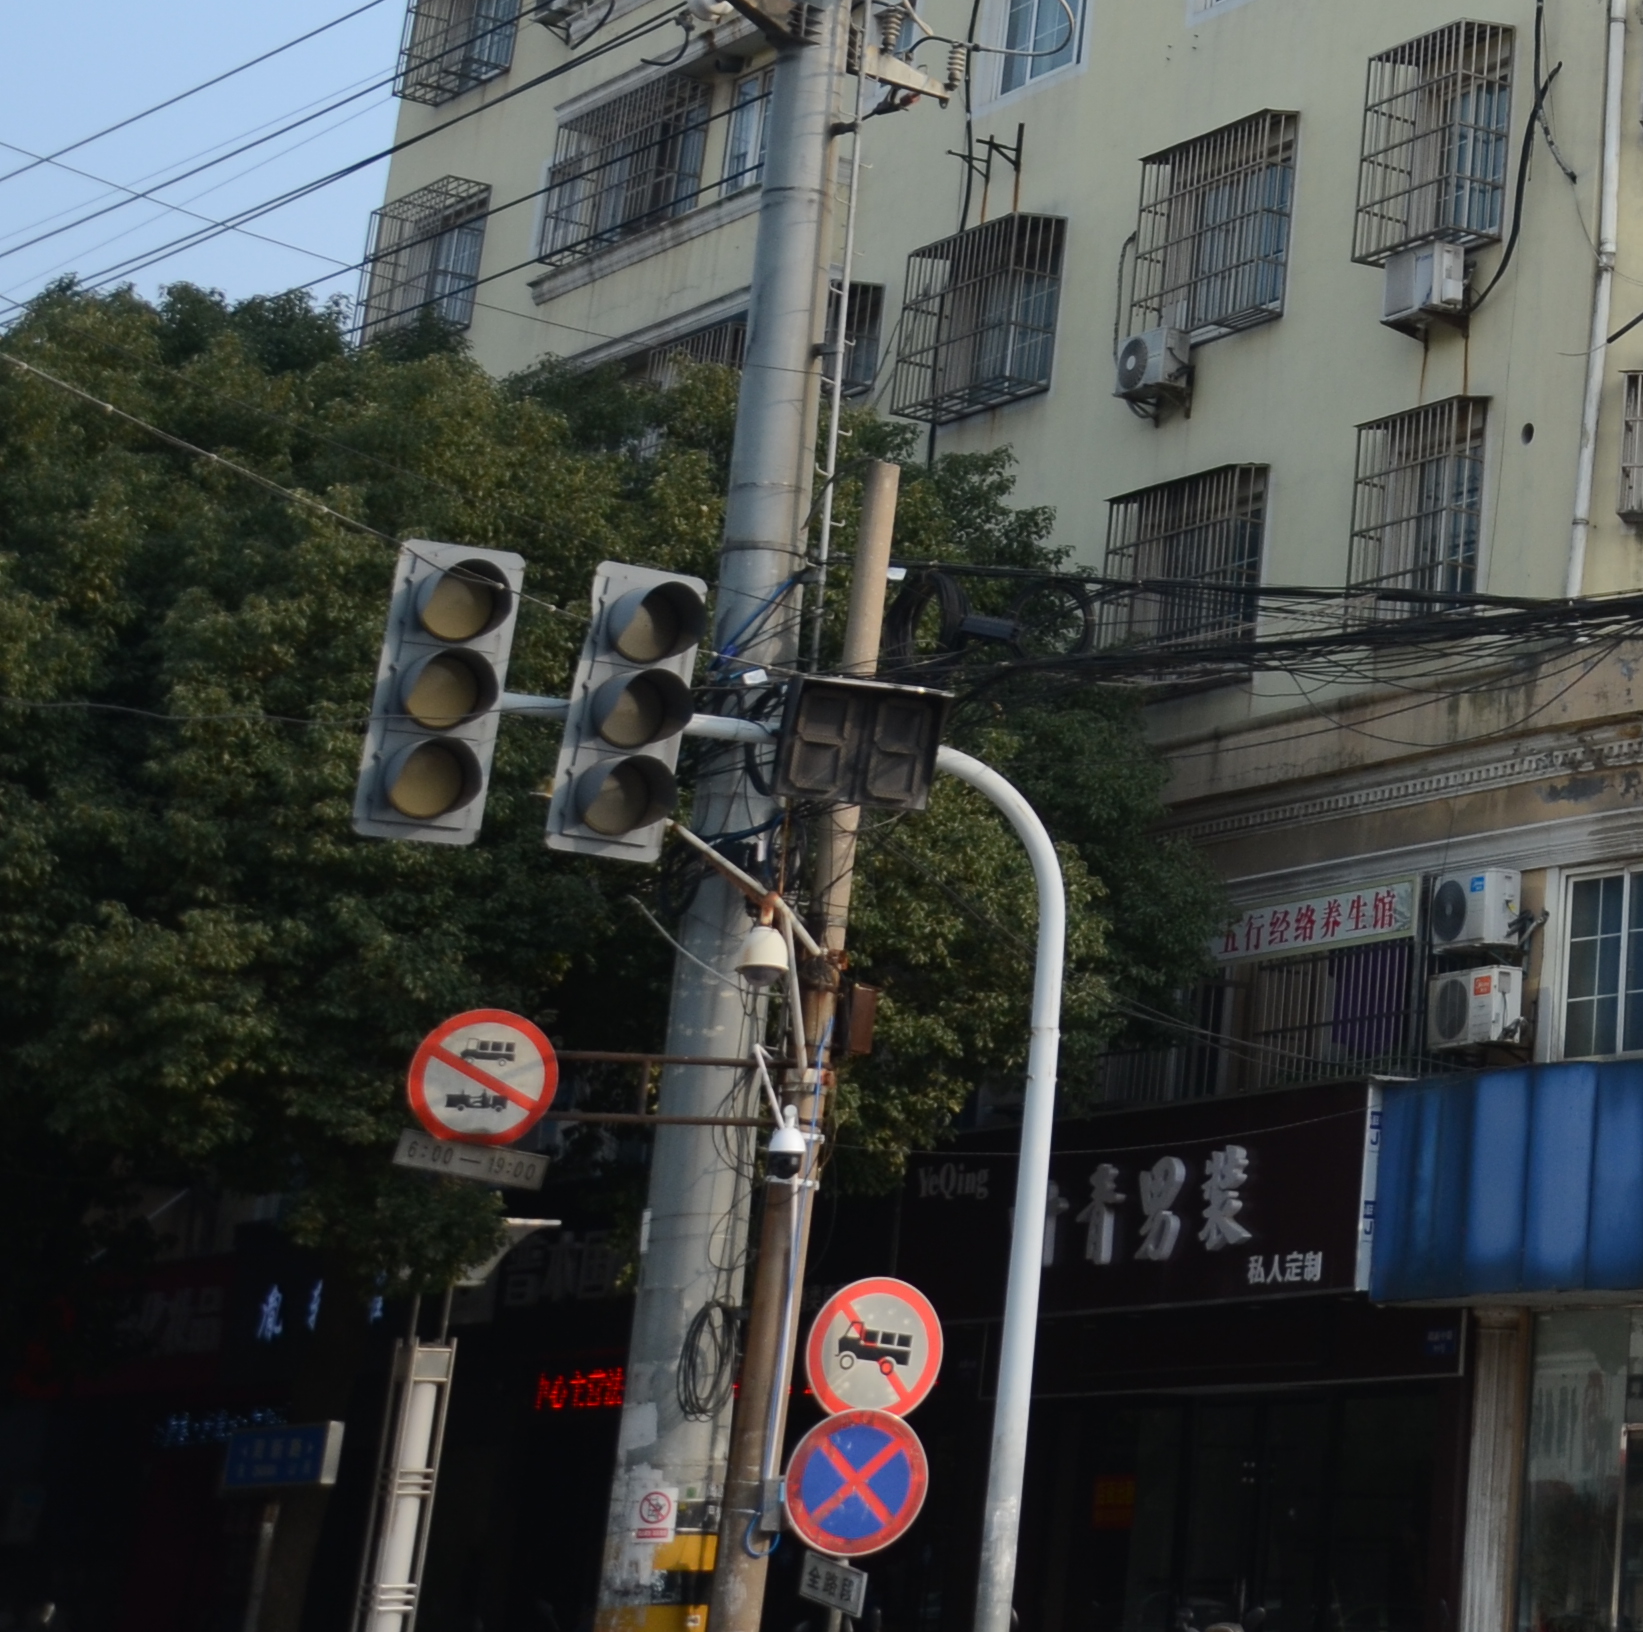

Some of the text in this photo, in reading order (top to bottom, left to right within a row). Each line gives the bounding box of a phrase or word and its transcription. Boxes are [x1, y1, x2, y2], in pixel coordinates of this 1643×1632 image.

[916, 1162, 991, 1201] YeQing
[1246, 1250, 1324, 1285] 私人定制
[806, 1565, 855, 1602] 全路段
